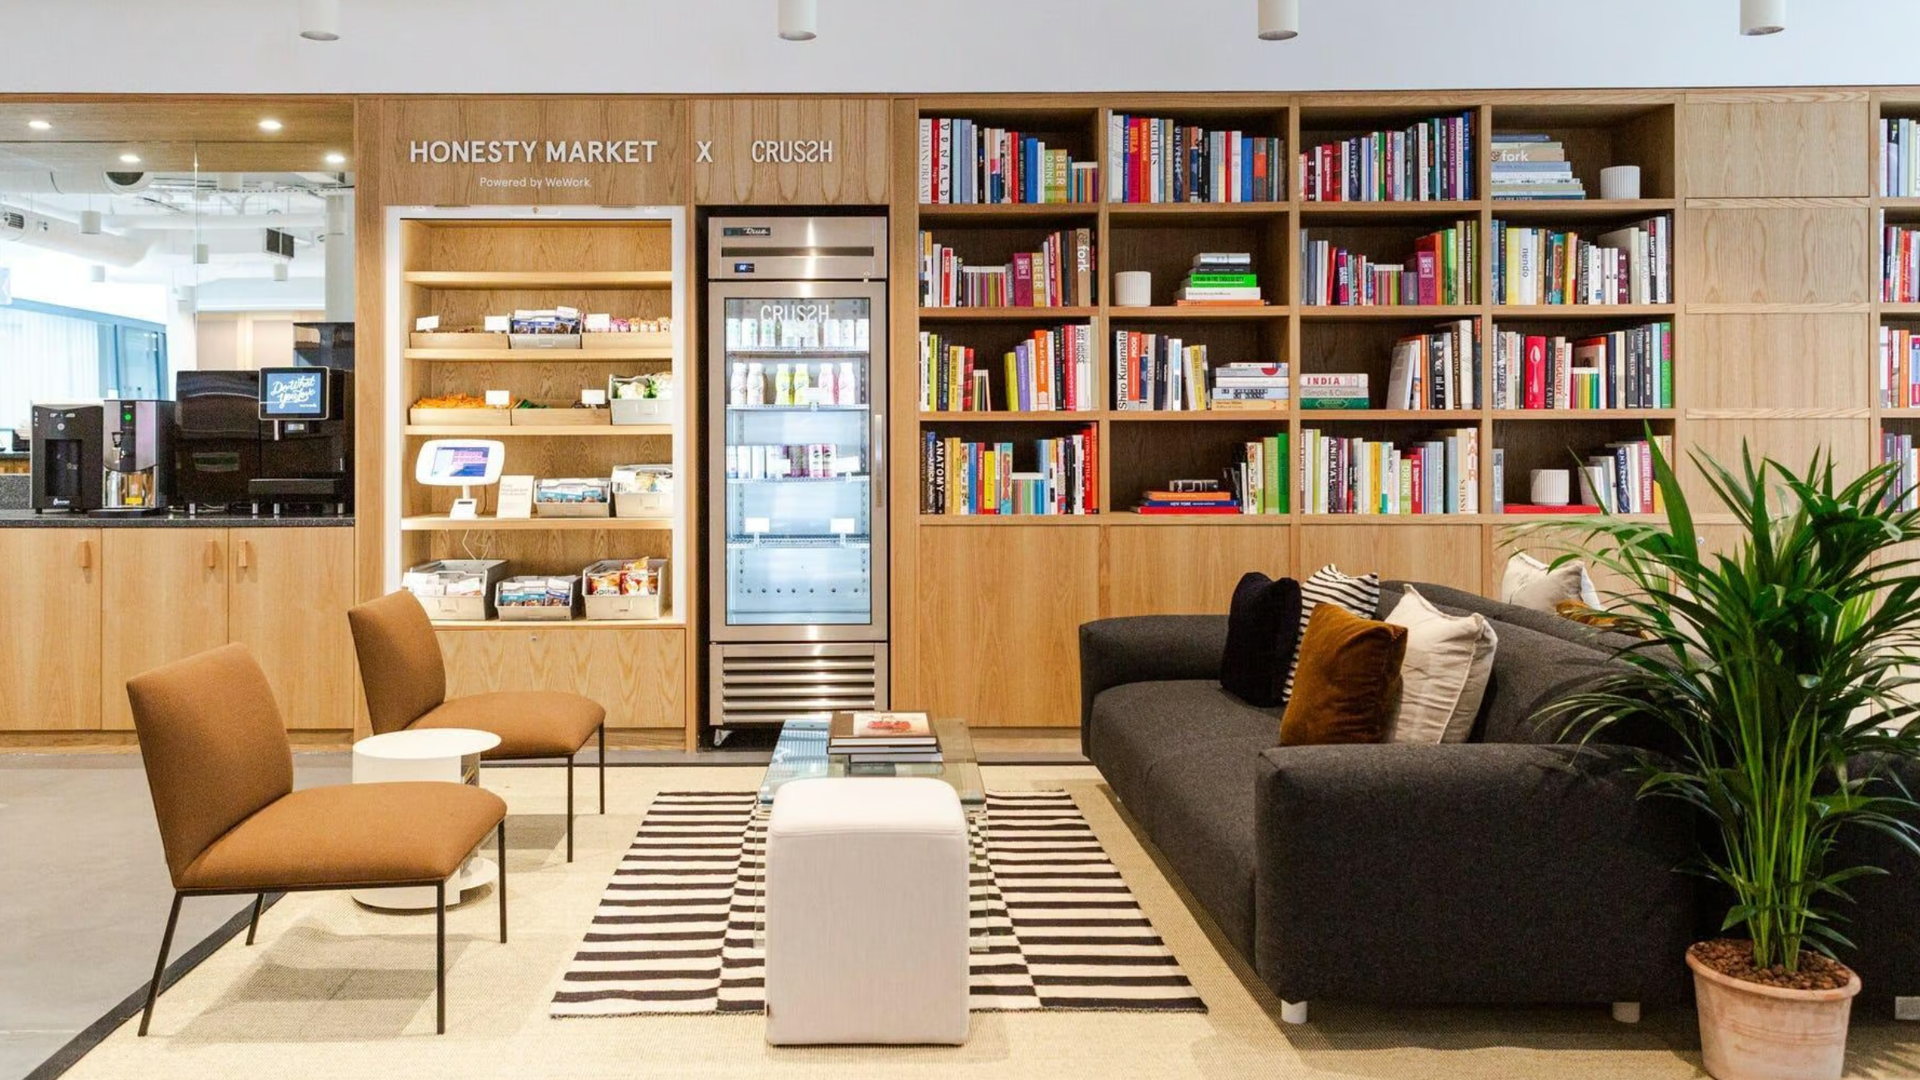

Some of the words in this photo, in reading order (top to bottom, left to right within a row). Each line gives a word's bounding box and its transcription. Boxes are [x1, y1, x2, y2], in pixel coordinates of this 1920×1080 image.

[410, 141, 537, 163] HONESTY
[547, 141, 657, 163] MARKET
[696, 141, 713, 163] X
[921, 124, 929, 161] ITALIAN
[1501, 150, 1528, 162] fork
[940, 123, 949, 196] DONALD
[1057, 155, 1065, 185] BEER
[480, 177, 526, 187] Powered
[530, 177, 543, 189] by
[921, 164, 929, 197] DREAM
[1078, 245, 1089, 272] fork
[1035, 259, 1043, 288] BEER
[1119, 332, 1127, 380] Kuramata
[1307, 377, 1340, 385] INDIA
[1119, 383, 1127, 409] Shiro
[936, 441, 944, 491] ANATOMY
